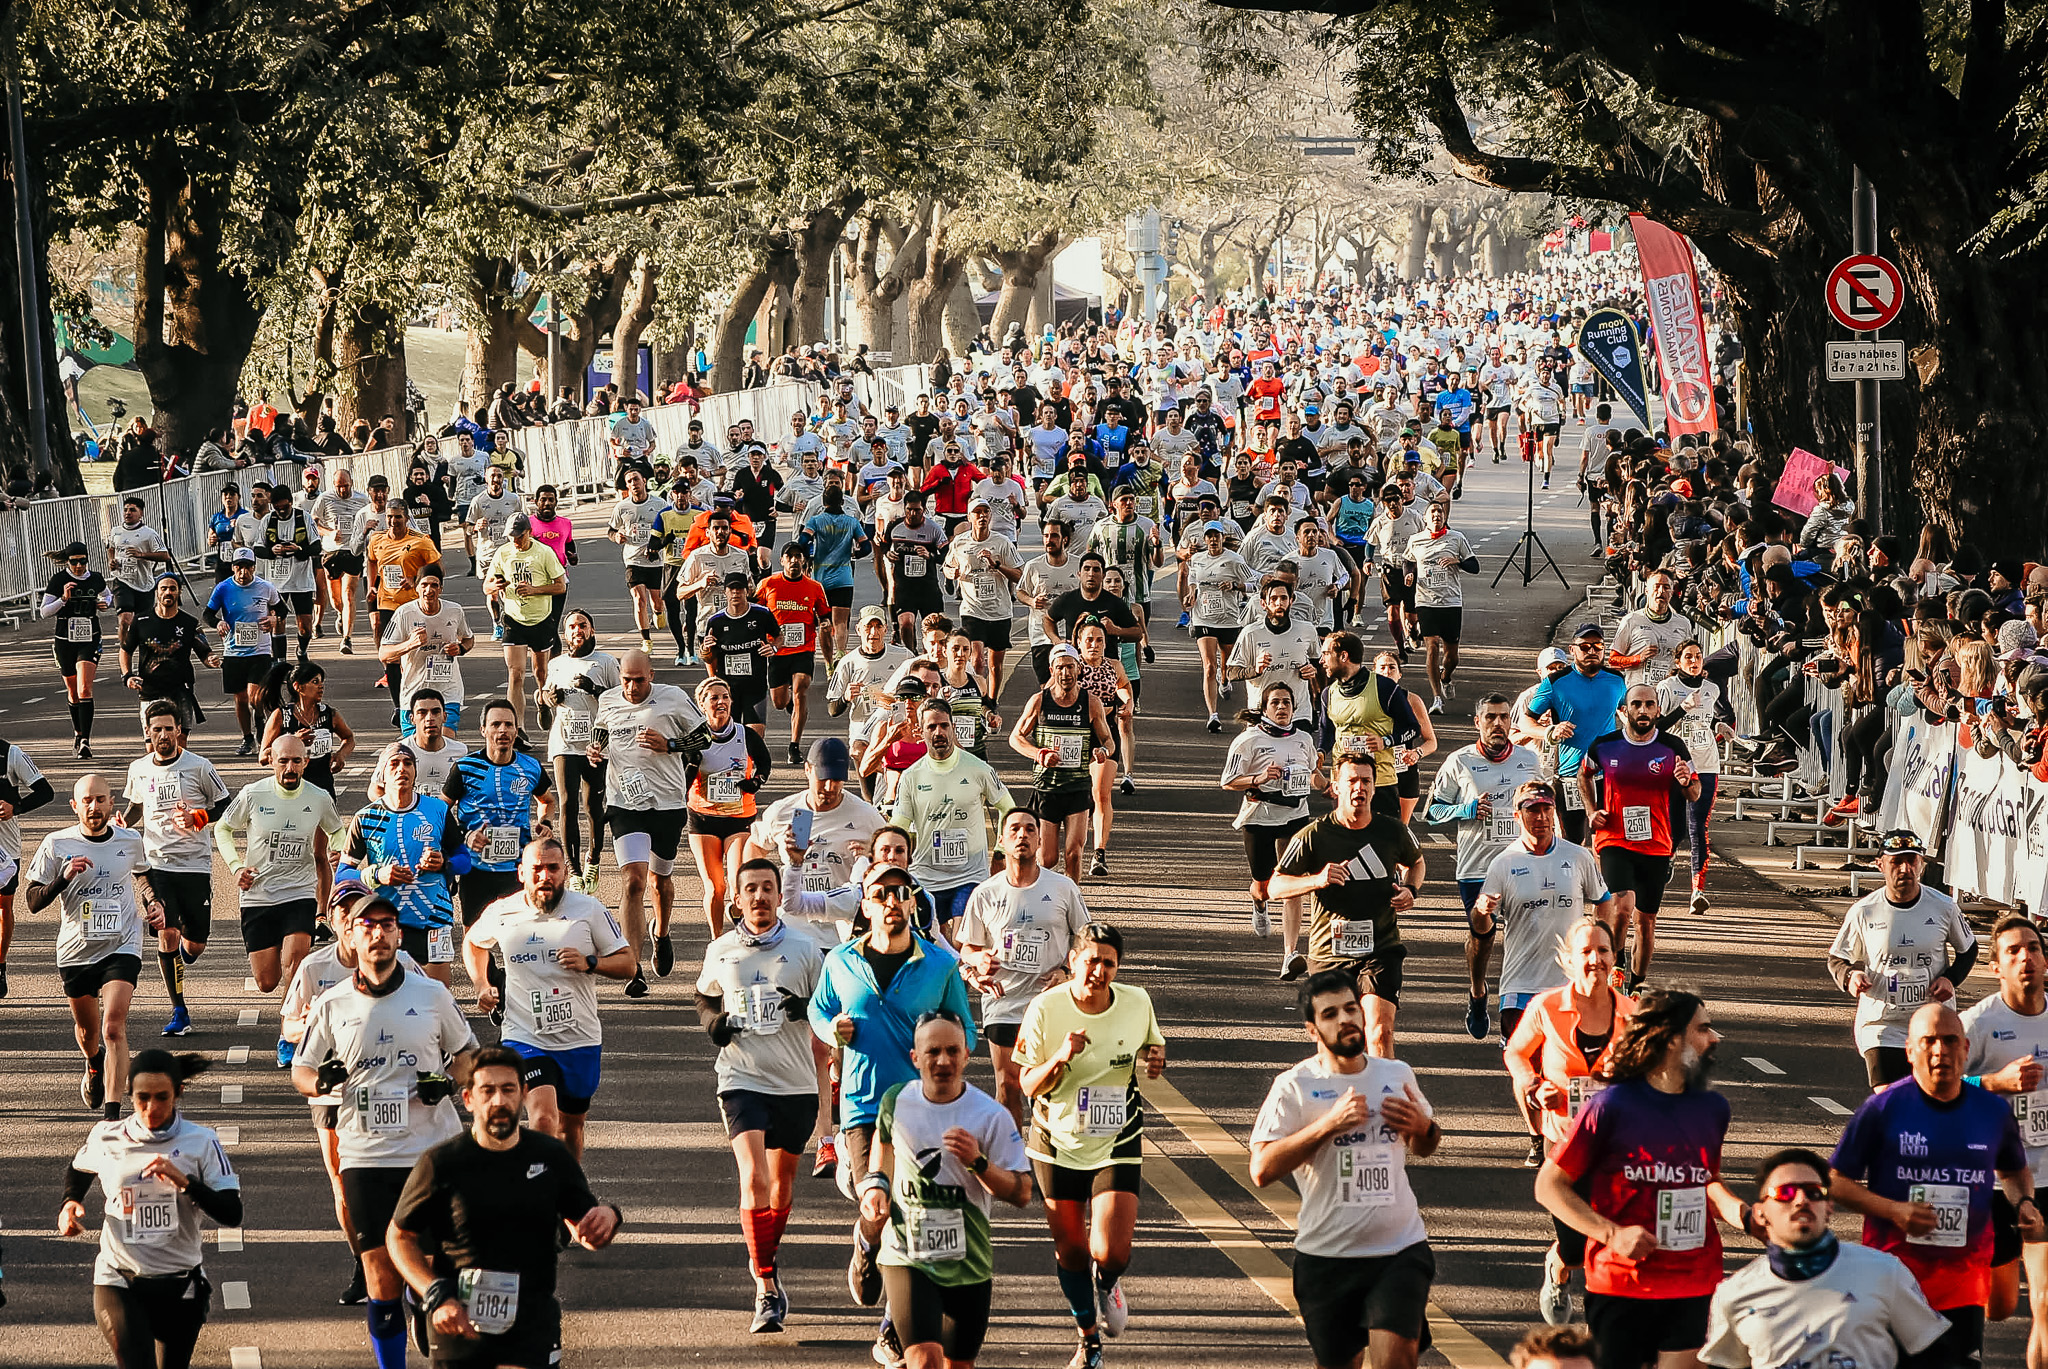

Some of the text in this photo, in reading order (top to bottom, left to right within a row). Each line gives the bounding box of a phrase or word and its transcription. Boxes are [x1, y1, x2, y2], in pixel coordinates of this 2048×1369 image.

[1599, 318, 1625, 329] moov
[1587, 325, 1627, 341] Running
[1607, 333, 1628, 345] Club
[1833, 349, 1898, 360] Días hábiles
[1832, 362, 1845, 372] de
[1850, 363, 1855, 372] 7
[1868, 363, 1879, 372] 21
[1883, 362, 1900, 372] hs.
[515, 561, 530, 573] WE
[514, 572, 532, 585] RUN
[1047, 712, 1081, 722] MIGUELES
[1062, 746, 1079, 760] 1542
[1627, 818, 1647, 833] 2591
[77, 886, 102, 898] osde
[82, 901, 90, 914] G
[92, 914, 118, 930] 14127
[510, 951, 538, 965] osde
[1015, 943, 1039, 963] 9251
[532, 992, 540, 1008] E
[1900, 984, 1926, 1003] 7090
[752, 1002, 777, 1023] 542
[356, 1055, 387, 1070] osde
[358, 1088, 367, 1105] E
[1080, 1089, 1088, 1106] F
[2017, 1096, 2027, 1115] E
[1089, 1104, 1124, 1125] 10755
[1356, 1168, 1389, 1192] 4098
[1897, 1166, 1951, 1182] BALMAS
[139, 1205, 171, 1228] 1905
[1936, 1207, 1963, 1232] 352
[927, 1228, 958, 1251] 5210
[476, 1293, 509, 1320] 5184
